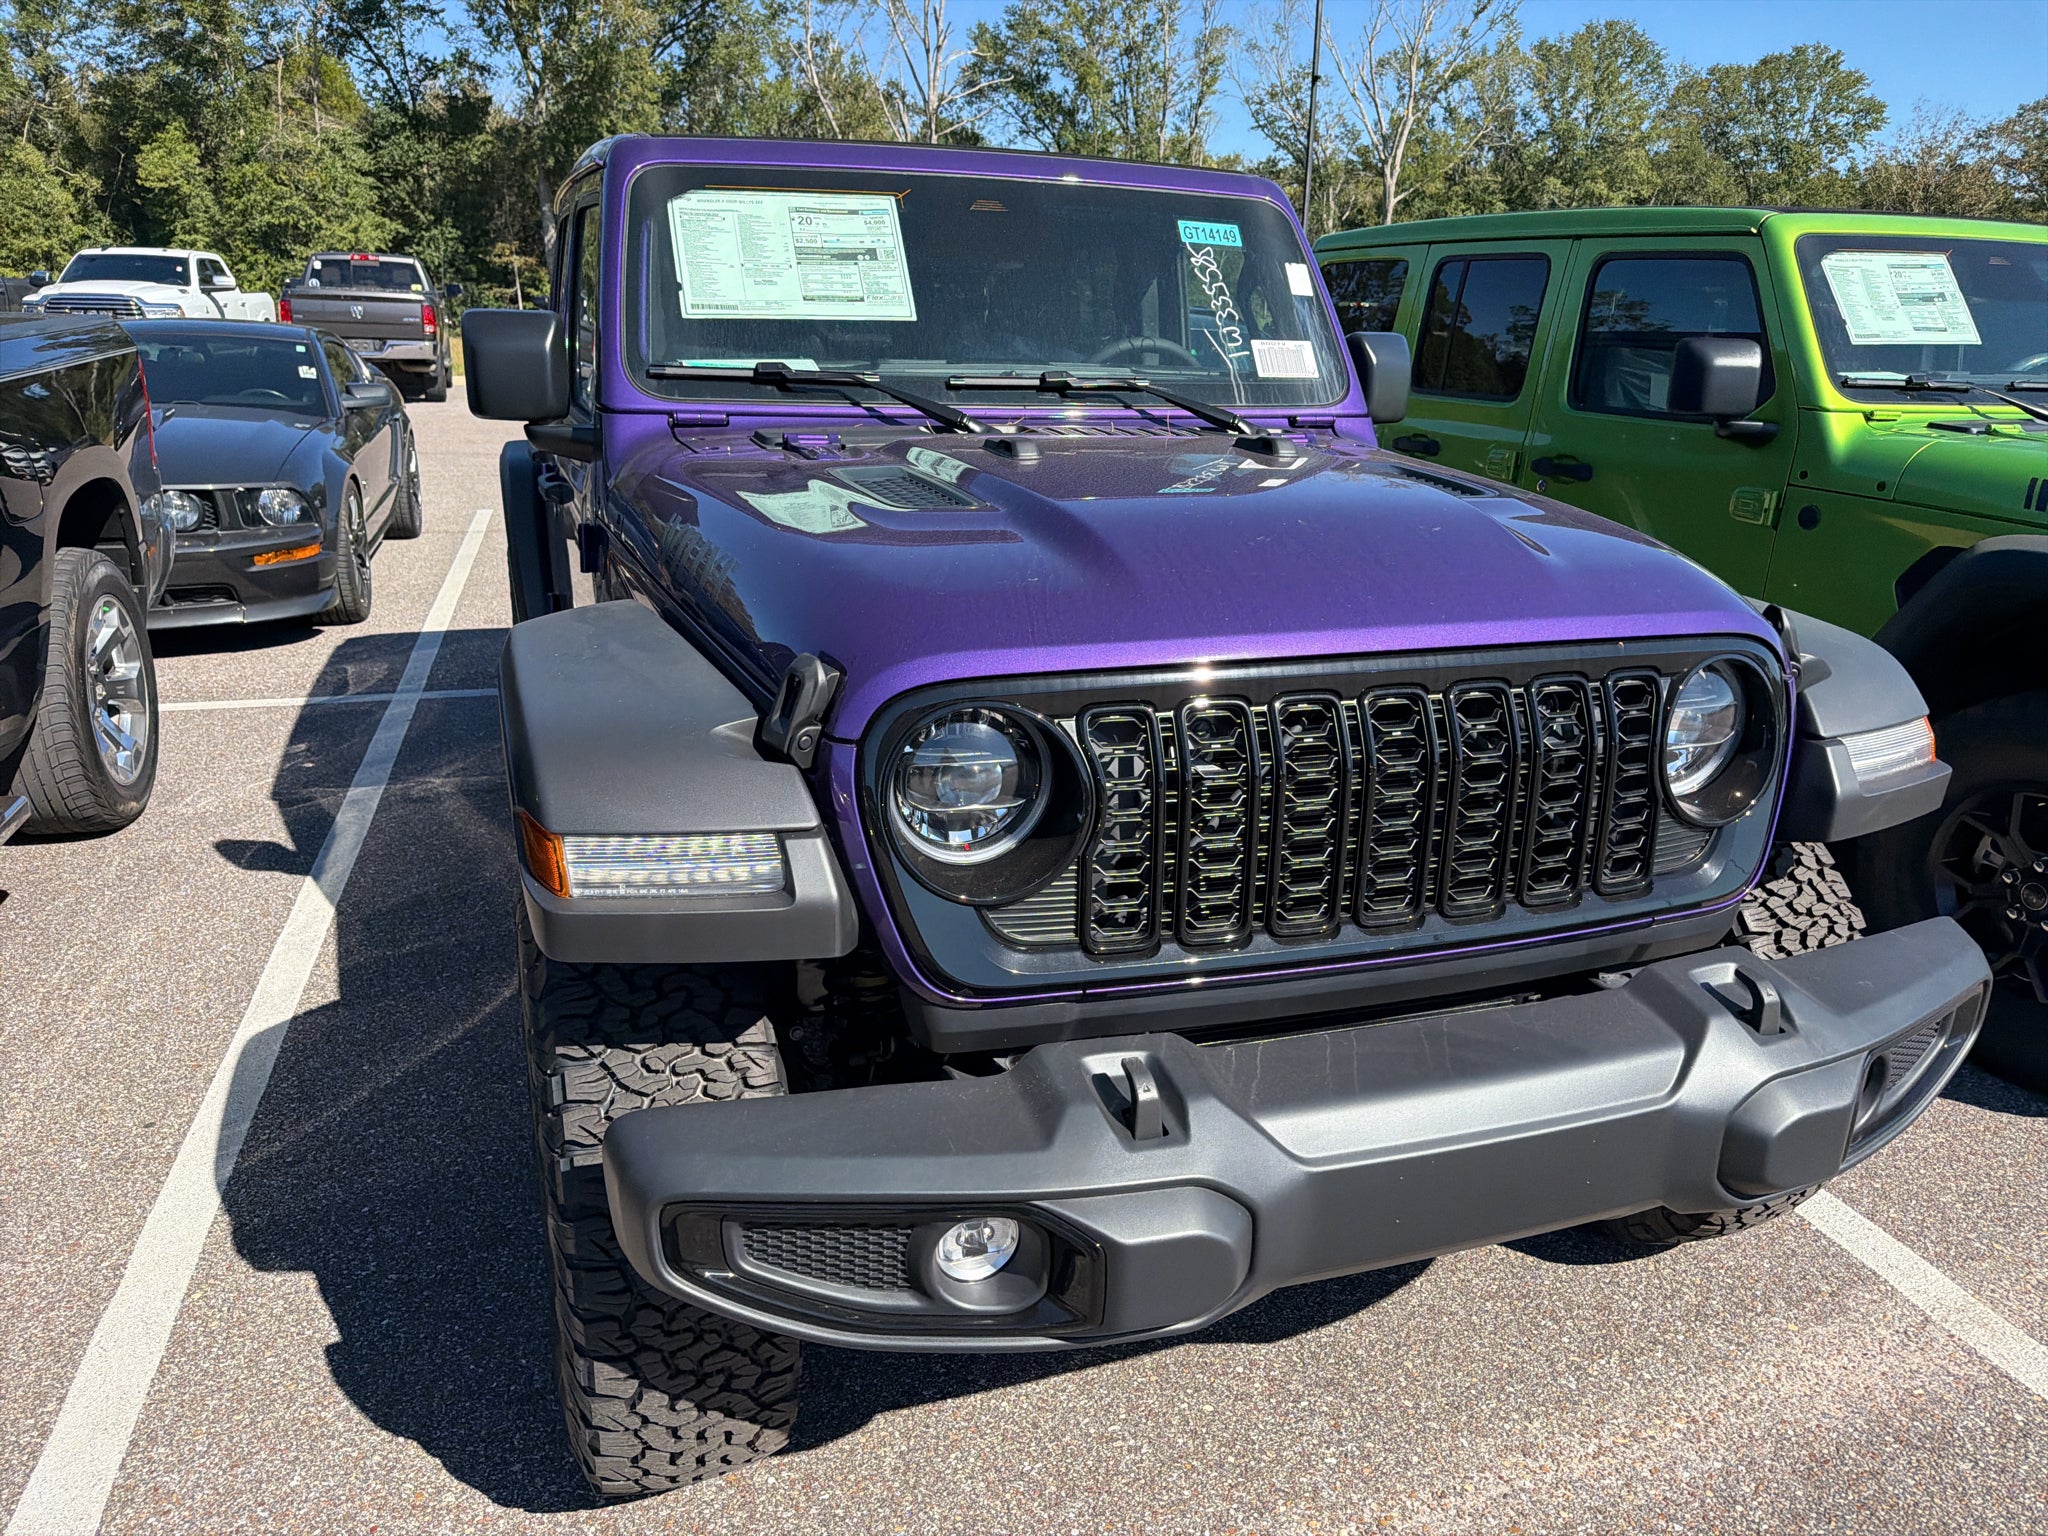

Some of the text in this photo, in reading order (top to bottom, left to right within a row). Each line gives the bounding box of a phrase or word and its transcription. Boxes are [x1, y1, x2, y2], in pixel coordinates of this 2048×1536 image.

[797, 215, 813, 226] 20
[1183, 225, 1237, 243] GT14149
[1893, 271, 1903, 279] 20
